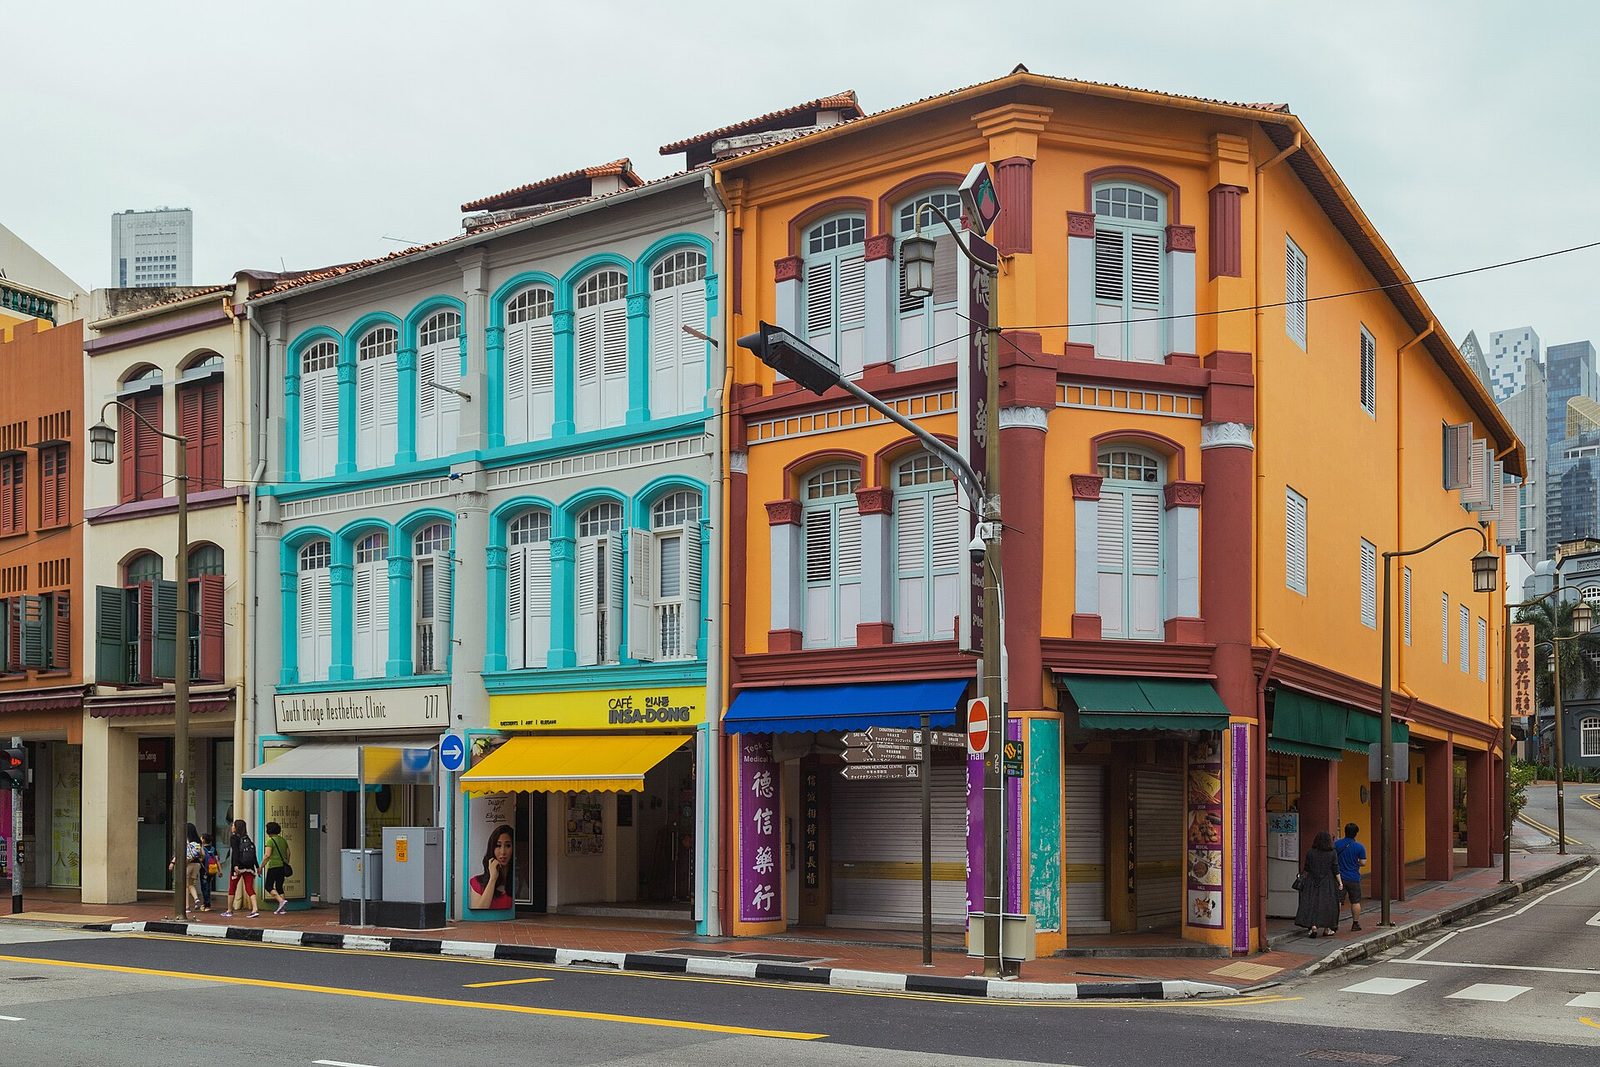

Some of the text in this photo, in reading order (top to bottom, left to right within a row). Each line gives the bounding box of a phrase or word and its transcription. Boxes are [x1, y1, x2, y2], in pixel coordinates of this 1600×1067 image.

[281, 694, 439, 725] South Bridge Aesthetics Clinic 277
[608, 695, 633, 709] CAFÉ
[645, 696, 669, 707] 인사동
[608, 706, 690, 724] INSA-DONG
[743, 742, 763, 754] Teck
[744, 755, 768, 763] Medical
[994, 753, 1000, 774] 25
[752, 770, 775, 912] 德信藥行
